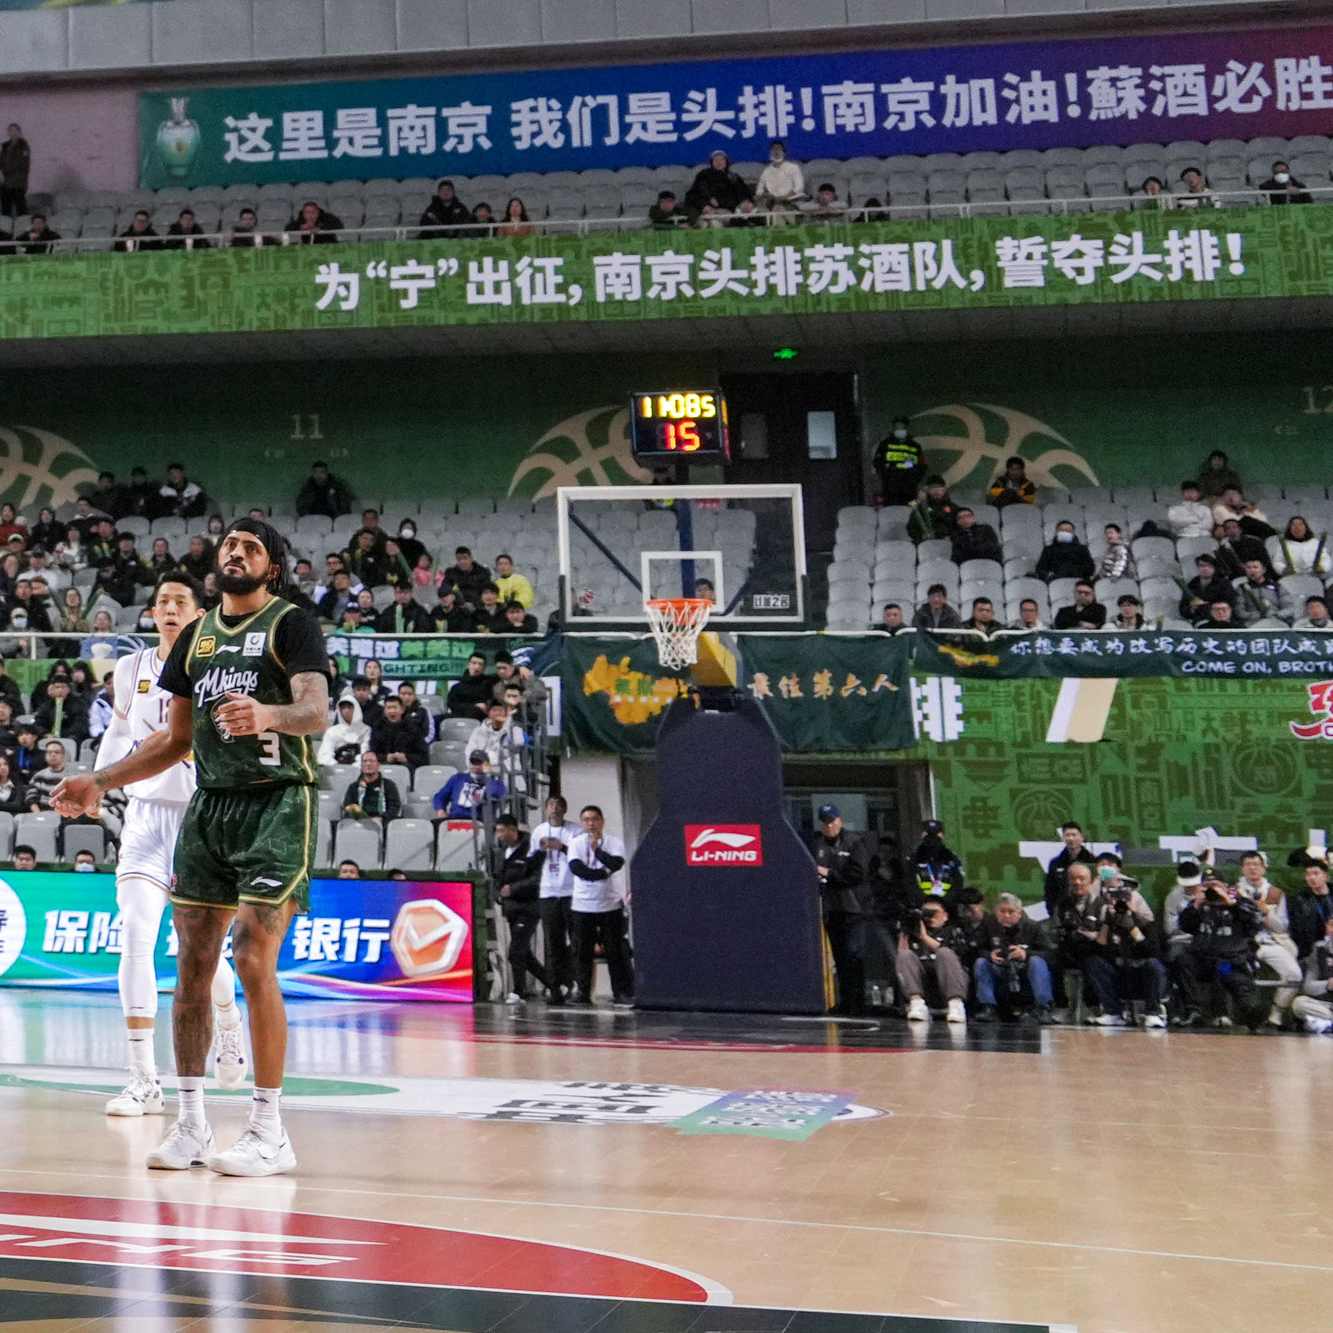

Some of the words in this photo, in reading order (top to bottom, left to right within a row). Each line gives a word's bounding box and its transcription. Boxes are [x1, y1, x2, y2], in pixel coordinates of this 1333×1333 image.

[223, 102, 493, 164] 这里是南京
[664, 420, 701, 452] 15
[1181, 661, 1236, 673] COME
[194, 665, 260, 708] Mkings
[257, 732, 282, 766] 3
[690, 848, 759, 863] LI-NING
[293, 917, 391, 964] 银行
